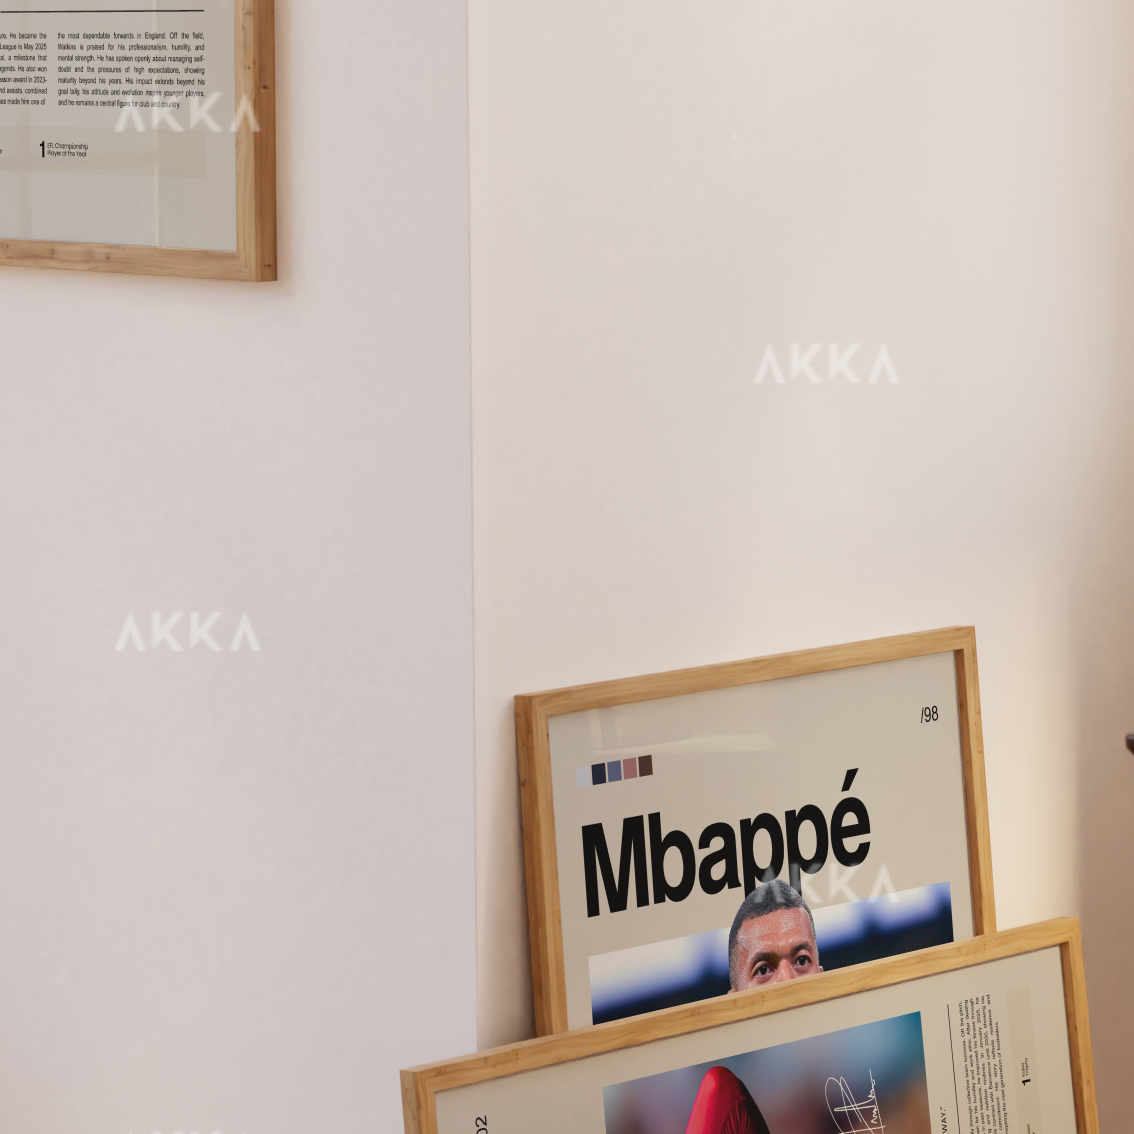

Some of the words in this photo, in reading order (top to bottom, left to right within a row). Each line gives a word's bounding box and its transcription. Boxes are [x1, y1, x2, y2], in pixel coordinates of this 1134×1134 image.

[40, 141, 45, 158] 1
[921, 705, 939, 724] /98
[581, 768, 871, 918] Mbappé
[1022, 1078, 1031, 1086] 1
